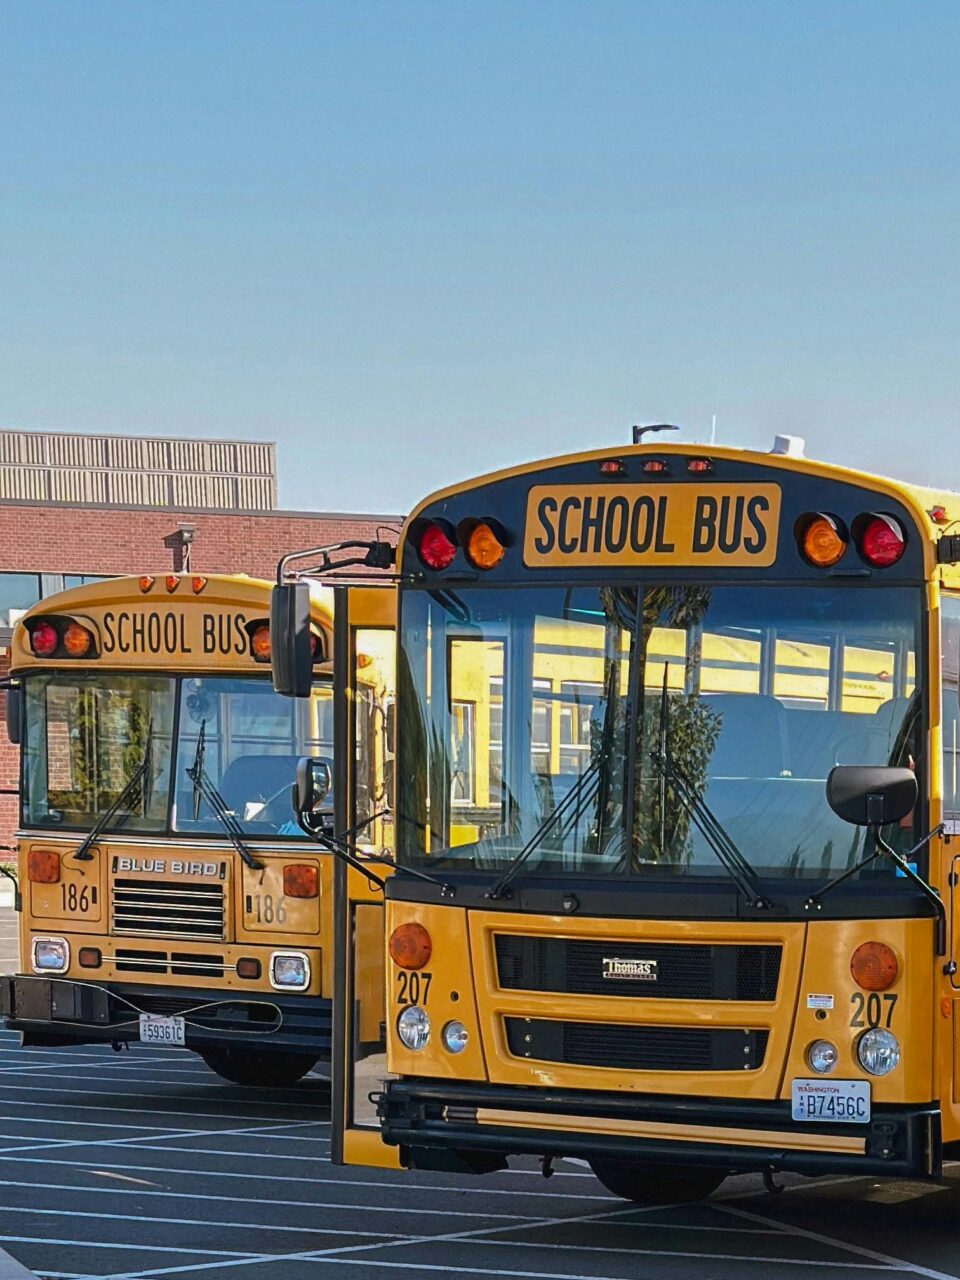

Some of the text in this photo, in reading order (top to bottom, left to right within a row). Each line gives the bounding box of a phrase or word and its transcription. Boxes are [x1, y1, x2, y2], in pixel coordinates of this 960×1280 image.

[534, 495, 770, 554] SCHOOL BUS
[103, 612, 247, 655] SCHOOL BUS
[119, 858, 218, 876] BLUE BIRD
[61, 883, 89, 912] 186
[255, 894, 287, 924] 186
[603, 958, 657, 974] Thomas
[397, 971, 432, 1006] 207
[849, 991, 898, 1029] 207
[147, 1024, 183, 1041] 59361C
[807, 1095, 865, 1116] B7456C
